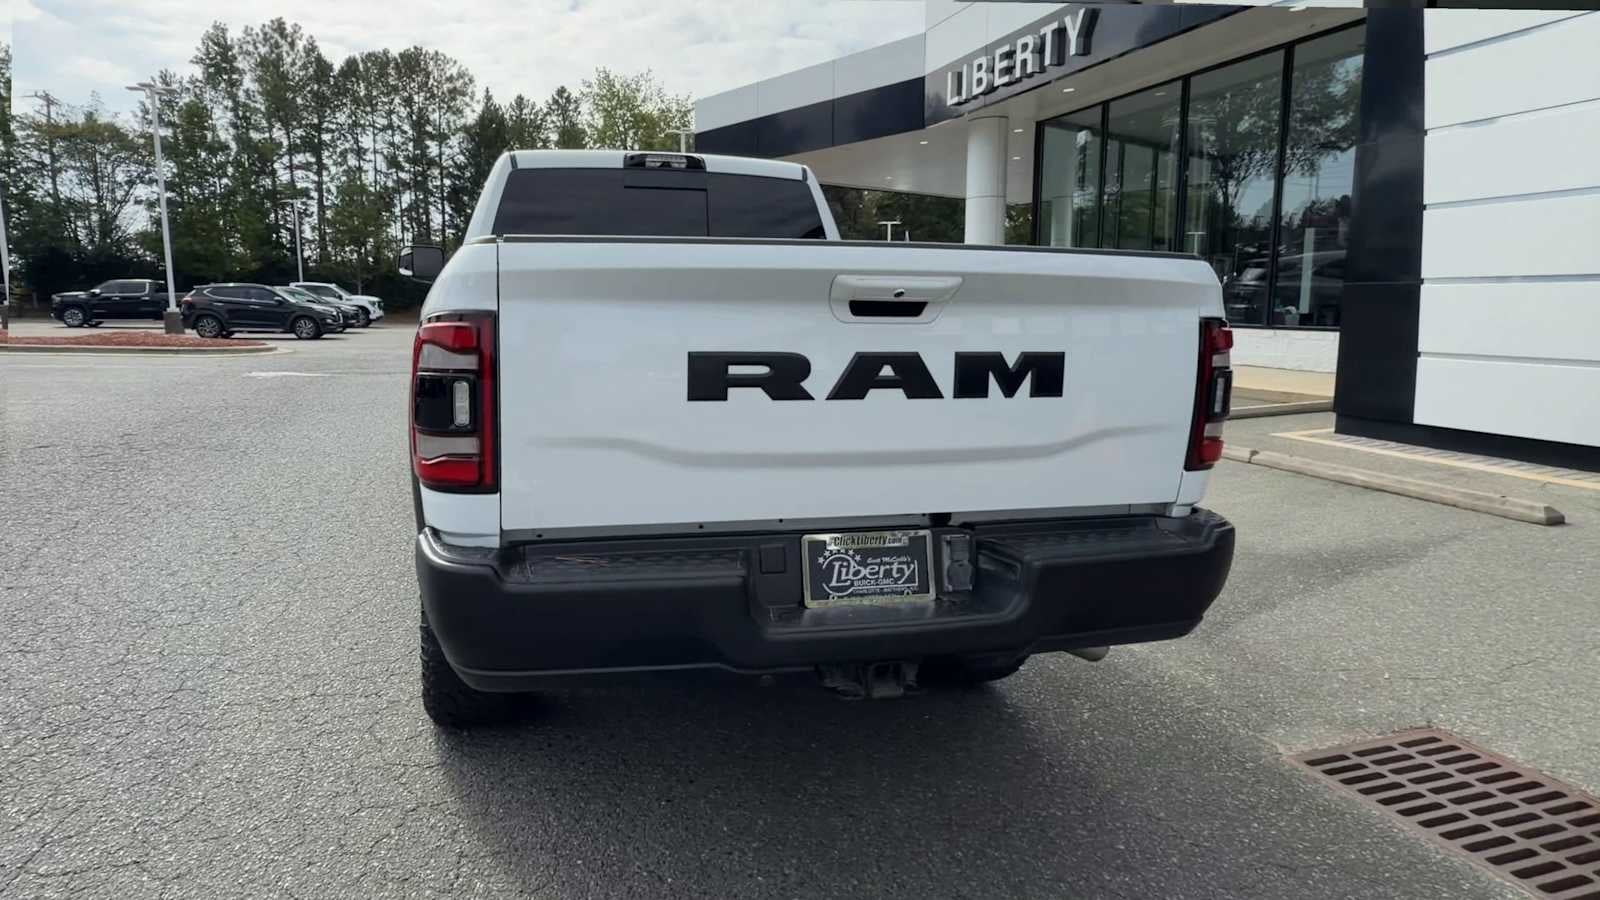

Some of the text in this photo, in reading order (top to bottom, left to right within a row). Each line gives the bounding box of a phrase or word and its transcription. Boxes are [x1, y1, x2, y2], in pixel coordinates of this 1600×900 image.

[946, 7, 1092, 107] LIBERTY
[687, 350, 1066, 401] RAM
[829, 560, 915, 588] Liberty
